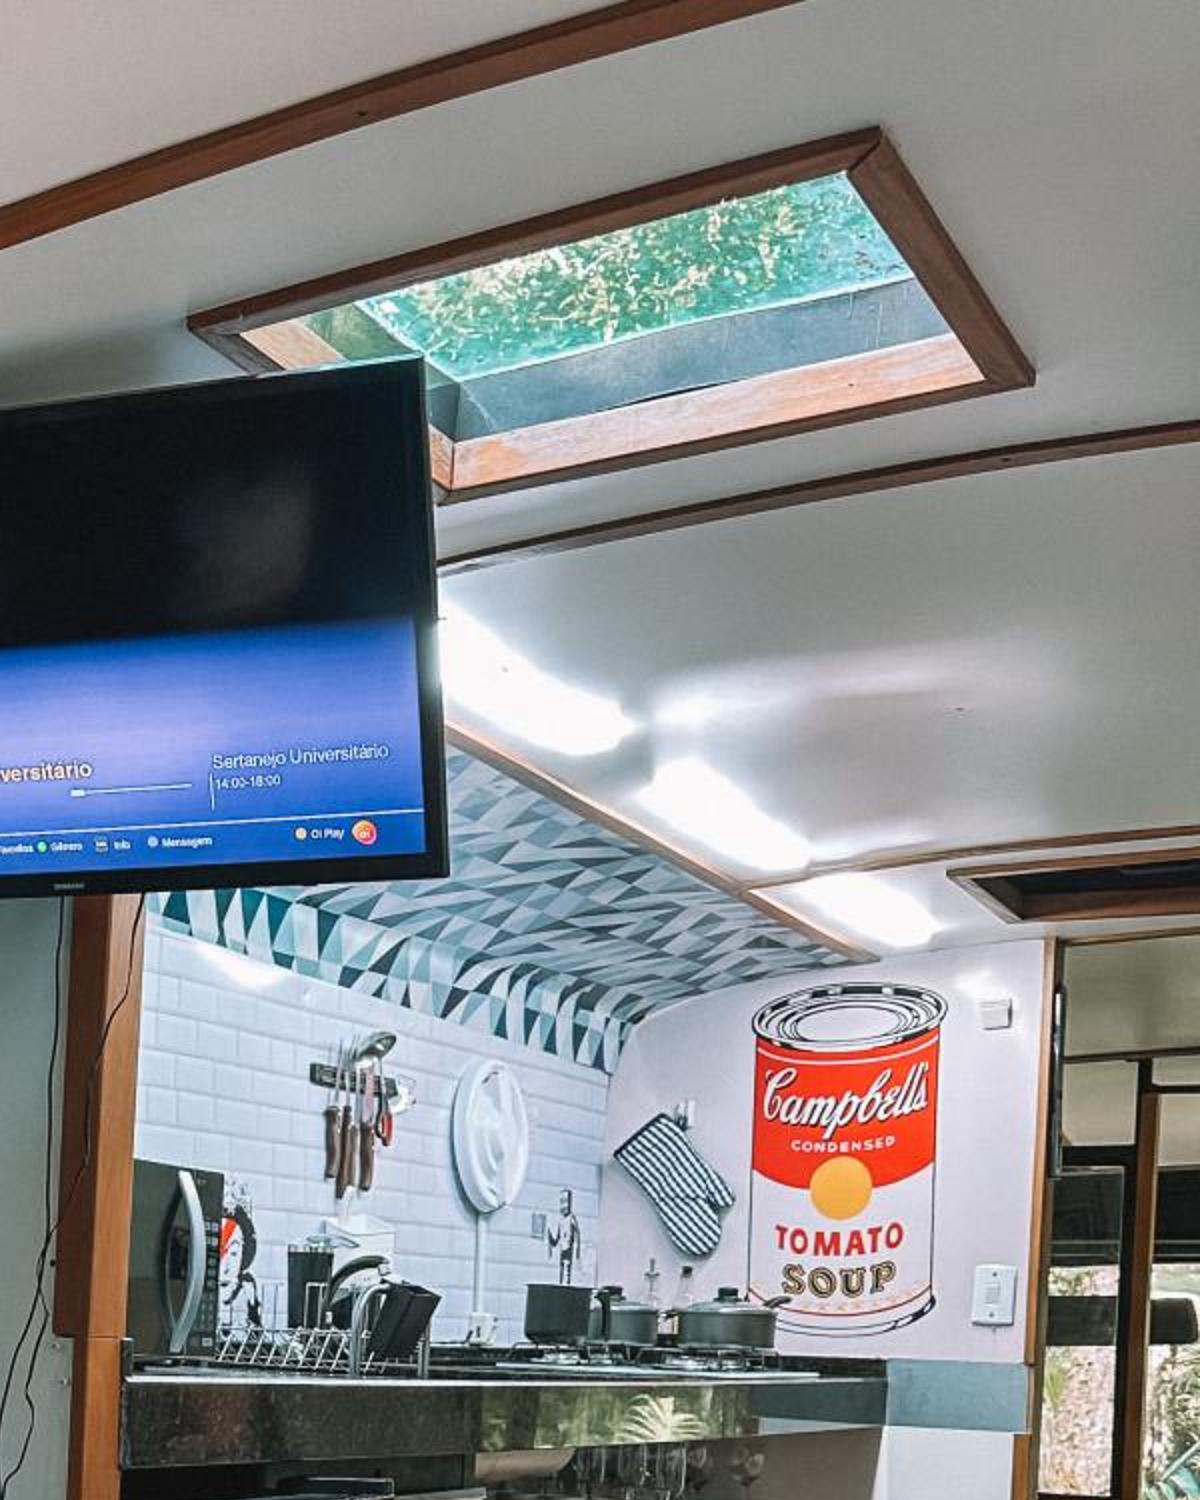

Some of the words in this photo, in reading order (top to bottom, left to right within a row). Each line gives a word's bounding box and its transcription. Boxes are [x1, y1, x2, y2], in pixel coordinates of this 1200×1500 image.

[213, 752, 286, 769] Sertanejo
[290, 743, 389, 765] Universitário
[763, 1061, 929, 1140] Campbell's
[791, 1135, 896, 1154] CONDENSED
[775, 1222, 905, 1258] TOMATO
[782, 1260, 897, 1299] SOUP
